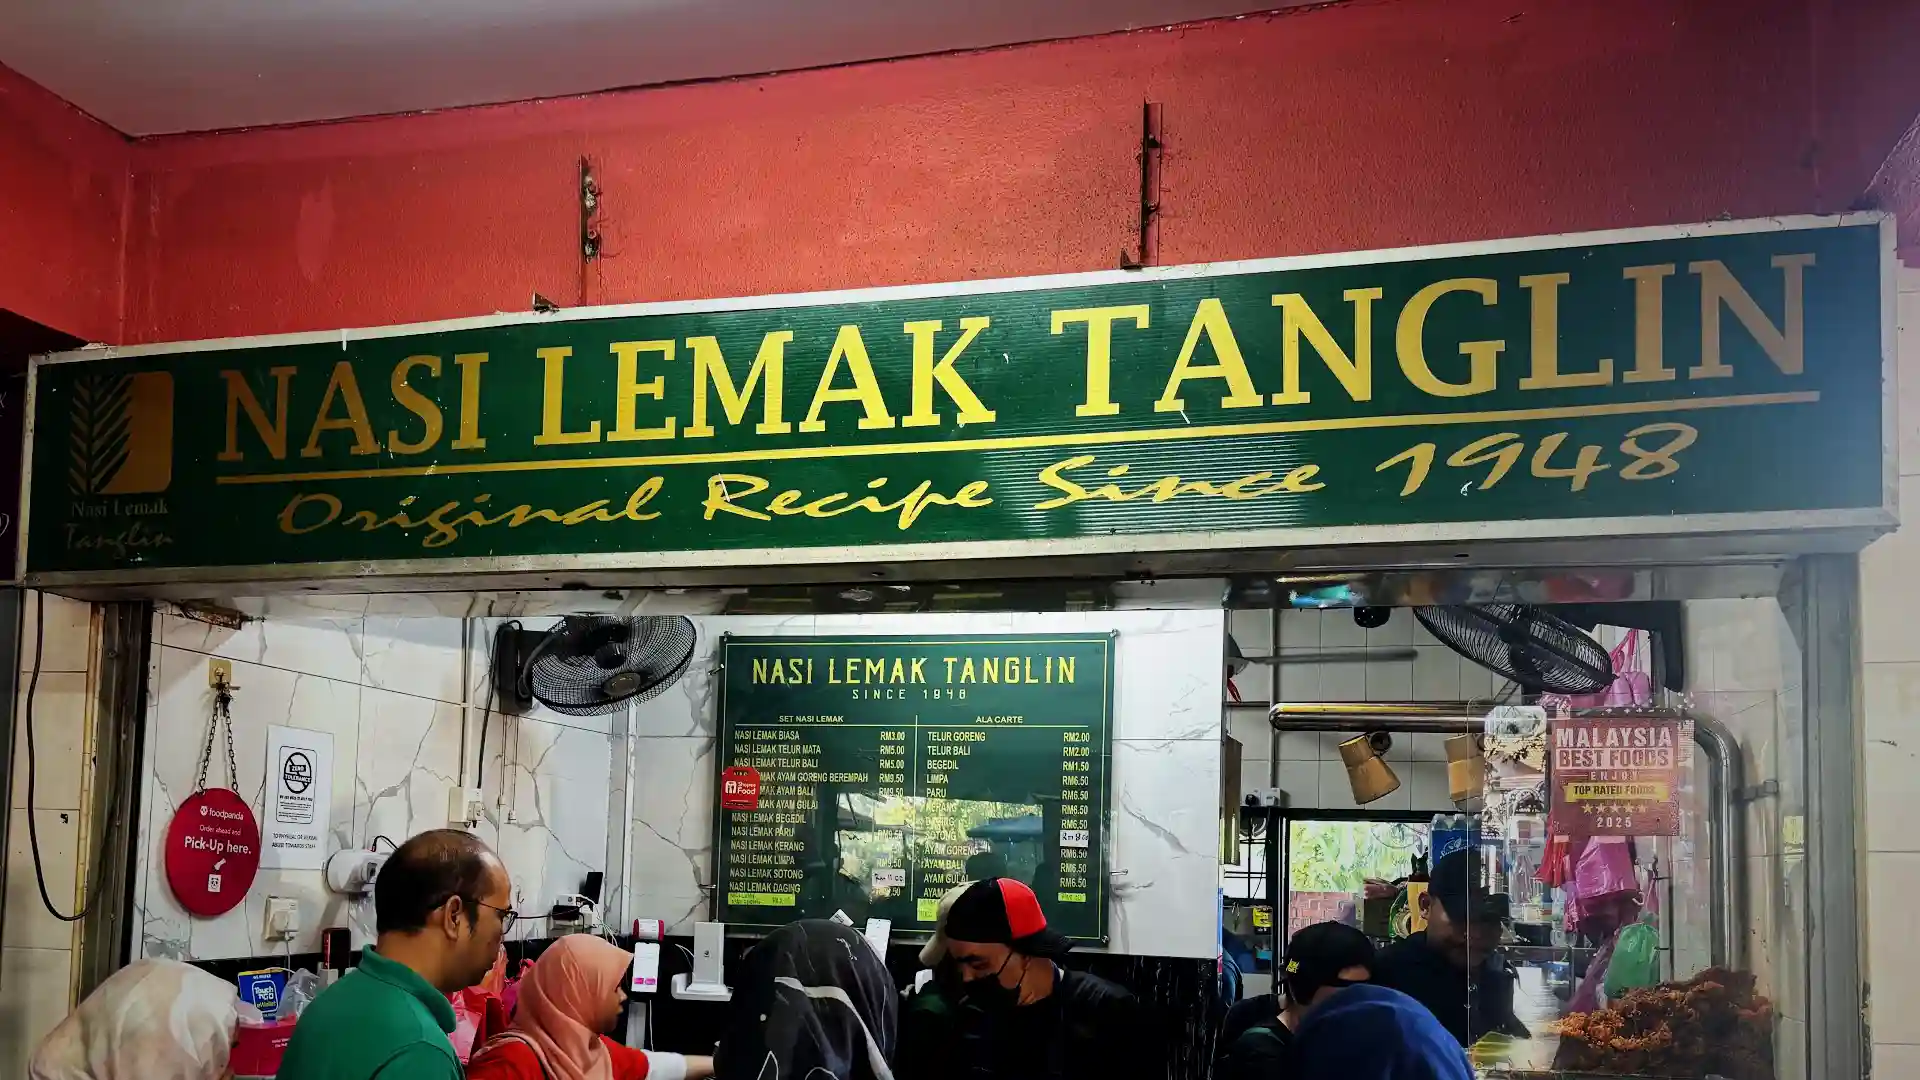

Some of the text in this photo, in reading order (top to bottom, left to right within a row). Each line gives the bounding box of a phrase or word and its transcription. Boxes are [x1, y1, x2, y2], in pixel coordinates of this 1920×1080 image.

[218, 253, 1816, 462] NASI LEMAK TANGLIN
[278, 422, 1699, 548] Original Recipe Since 1948
[72, 498, 168, 517] Nasi Lemak
[64, 522, 174, 559] Tanglin
[752, 656, 1076, 684] NASI LEMAK TANGLIN
[852, 688, 966, 700] SINCE 1948
[735, 731, 905, 741] NASI LEMAK BIASA RM3.00
[928, 732, 1089, 742] TELUR GORENG RM2.00
[1556, 727, 1672, 748] MALAYSIA
[734, 744, 904, 755] NASI LEMAK TELUR MATA RM5.00
[928, 746, 1089, 756] TELUR BALI RM2.00
[734, 758, 904, 769] NASI LEMAK TELUR BALI RM5.00
[1559, 750, 1669, 767] BEST FOODS
[927, 760, 1089, 771] BEGEDIL RM1.50
[284, 774, 312, 782] TOLERANCE
[777, 772, 796, 782] AYAM
[798, 772, 827, 782] GORENG
[830, 773, 868, 782] BEREMPAH
[879, 774, 904, 783] RM9.50
[926, 774, 1088, 786] LIMPA RM6.50
[1590, 771, 1640, 780] ENJOY
[737, 787, 756, 795] Food
[776, 786, 795, 796] AYAM
[798, 786, 813, 796] BALI
[926, 788, 1088, 800] PARU RM6.50
[1574, 786, 1591, 794] TOP
[1594, 785, 1622, 794] RATED
[776, 800, 795, 809] AYAM
[796, 800, 818, 810] GULAI
[1062, 805, 1088, 814] RM6.50
[209, 808, 244, 821] foodpanda
[732, 813, 806, 823] NASI LEMAK BEGEDIL
[1062, 820, 1087, 829] RM6.50
[1597, 817, 1632, 828] 2025
[200, 824, 215, 833] Order
[216, 825, 230, 834] ahead
[732, 827, 747, 836] NASI
[749, 827, 773, 836] LEMAK
[775, 828, 794, 837] PARU
[925, 831, 956, 840] SOTONG
[184, 836, 251, 854] Pick-Up here.
[731, 841, 804, 851] NASI LEMAK KERANG
[924, 845, 1087, 858] AYAM GORENG RM6.50
[730, 854, 746, 864] NASI
[748, 855, 772, 864] LEMAK
[774, 855, 794, 864] LIMPA
[924, 860, 1086, 873] AYAM BALI RM6.50
[730, 868, 803, 879] NASI LEMAK SOTONG
[924, 874, 1086, 888] AYAM GULAI RM6.50
[729, 882, 745, 891] NASI
[747, 882, 772, 892] LEMAK
[773, 883, 800, 893] DAGING
[924, 888, 944, 898] AYAM
[254, 986, 273, 994] Touch
